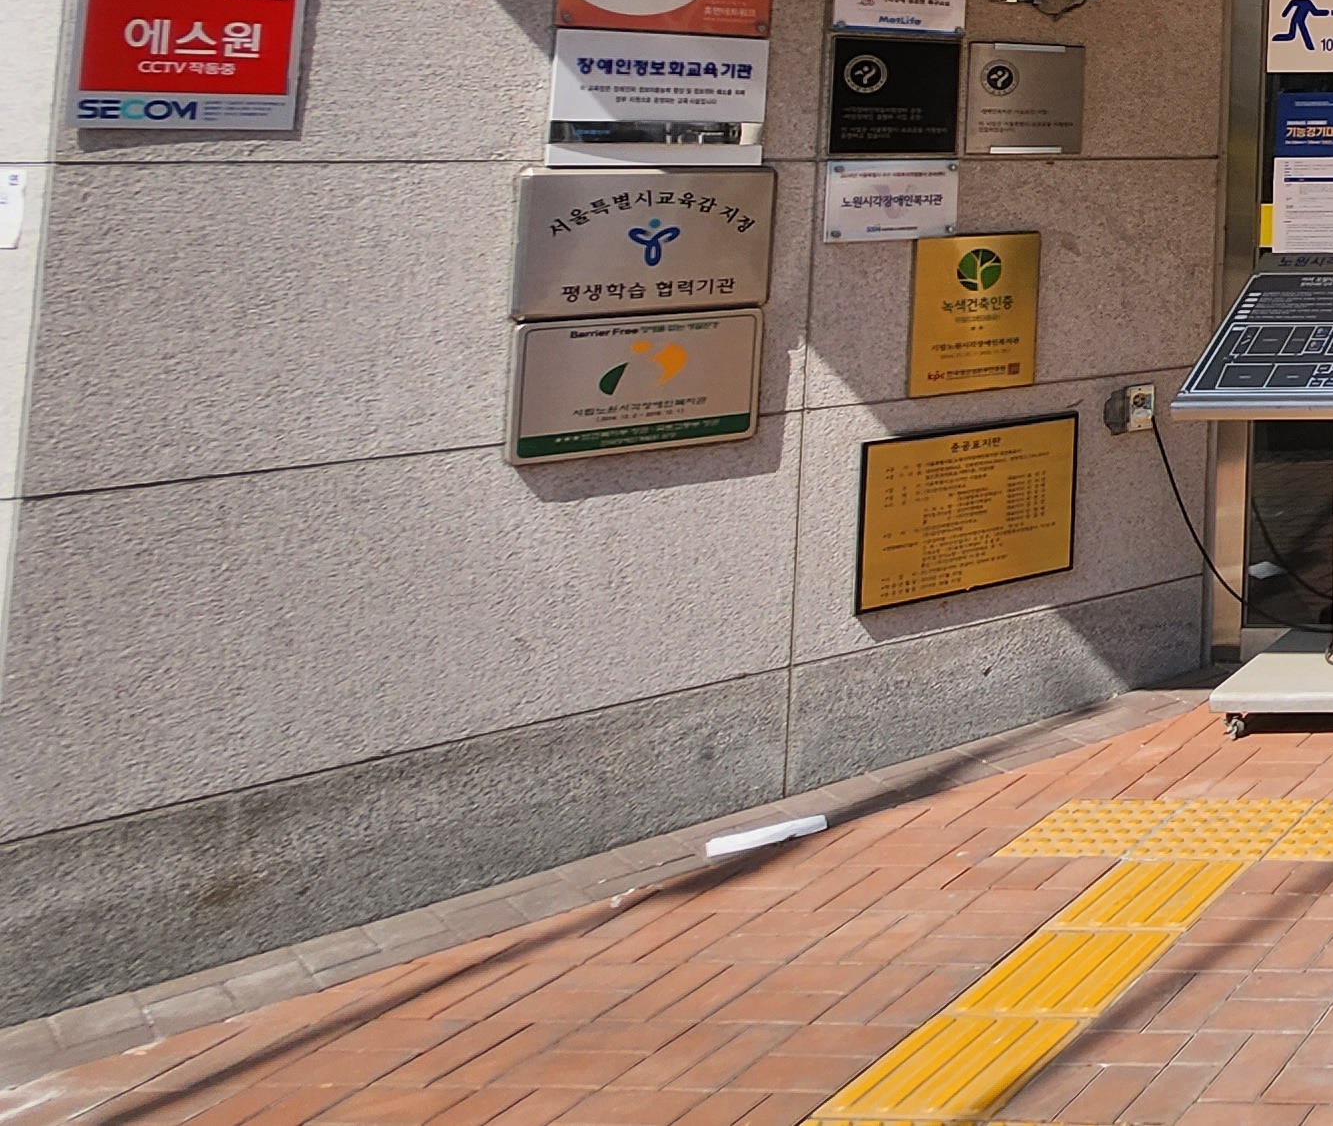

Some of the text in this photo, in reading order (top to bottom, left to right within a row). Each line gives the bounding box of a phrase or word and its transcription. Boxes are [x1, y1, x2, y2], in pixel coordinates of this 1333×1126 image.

[124, 19, 262, 58] 에스원
[138, 60, 236, 75] CCTV 작동중
[576, 57, 753, 80] 장애인정보화교육기관
[77, 98, 198, 121] SECOM
[841, 194, 943, 209] 노원시각장애인복지관
[549, 189, 756, 238] 서울특별시교육감 지정
[561, 278, 735, 302] 평생학습 협력기관
[941, 295, 1013, 313] 녹색건축인증
[569, 327, 611, 339] Barrier
[612, 326, 638, 337] Free
[951, 437, 1001, 453] 준공표지판
